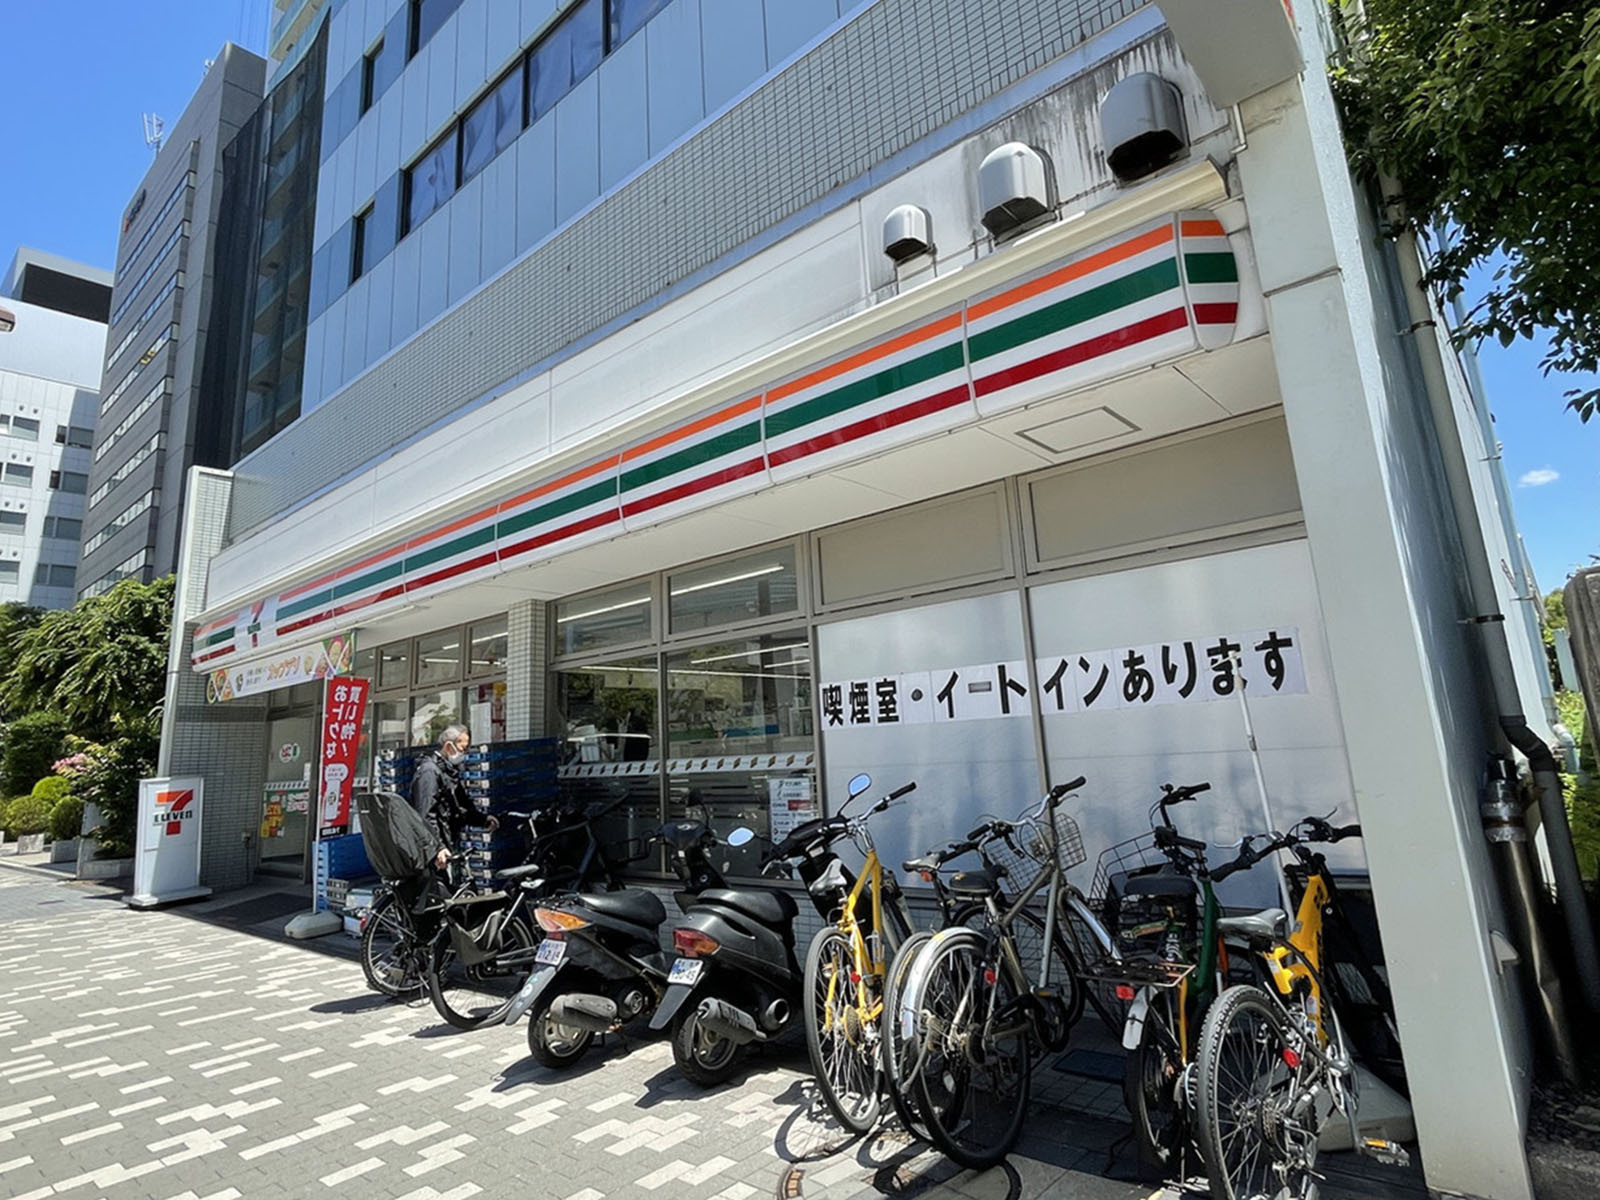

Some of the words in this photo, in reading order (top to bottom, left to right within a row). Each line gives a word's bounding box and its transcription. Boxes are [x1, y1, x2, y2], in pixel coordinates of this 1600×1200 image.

[822, 631, 1293, 727] 喫煙室・イートインあります
